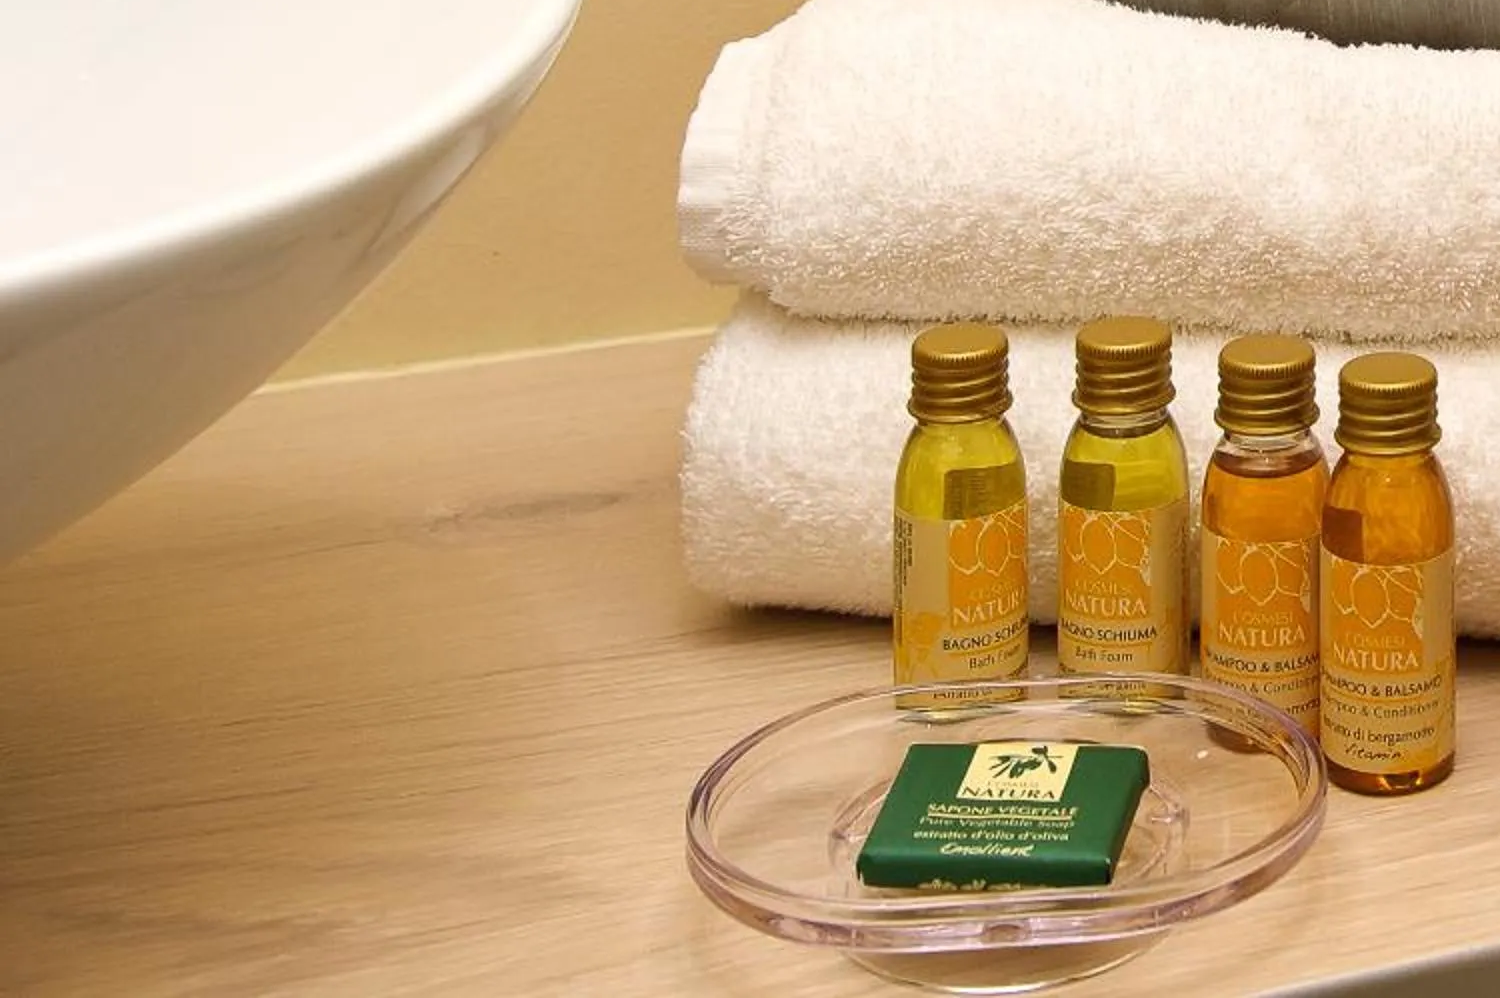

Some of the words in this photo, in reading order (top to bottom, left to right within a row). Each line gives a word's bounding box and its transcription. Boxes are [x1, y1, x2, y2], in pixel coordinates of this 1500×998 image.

[1065, 588, 1148, 618] NATURA
[1097, 625, 1158, 642] SCHIUMA
[1219, 621, 1305, 647] NATURA
[943, 633, 992, 651] BAGNO
[1333, 641, 1418, 672] NATURA
[1259, 662, 1271, 673] &
[1371, 685, 1380, 697] &
[1385, 673, 1442, 697] BALSAMO
[1353, 727, 1365, 741] di
[962, 786, 1056, 800] NATURA
[927, 802, 994, 815] SAPONE
[998, 805, 1079, 817] VEGETALE
[959, 817, 1033, 828] Vegetable
[912, 829, 968, 840] estratto
[1017, 830, 1070, 842] d'oliva
